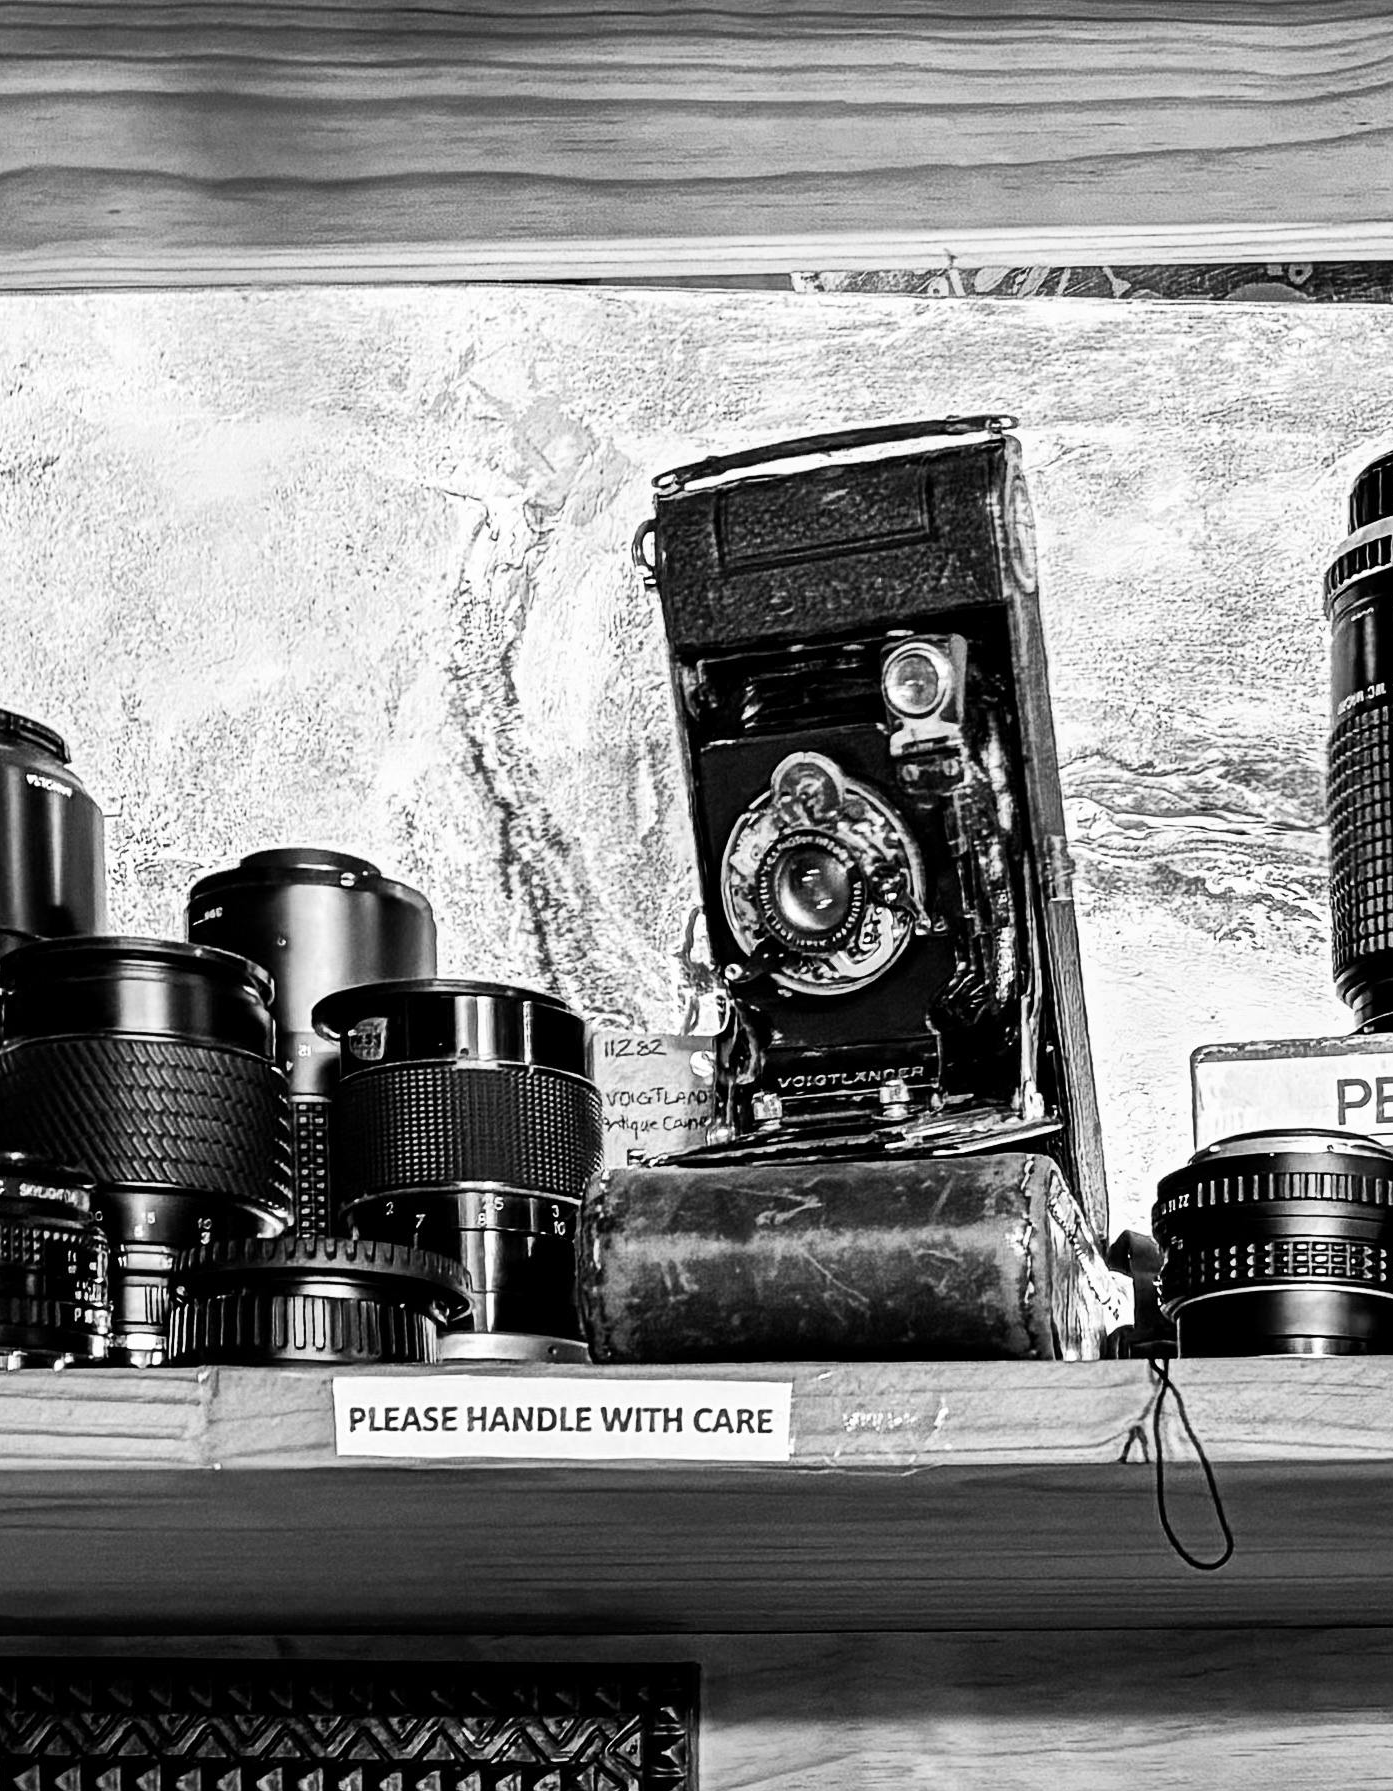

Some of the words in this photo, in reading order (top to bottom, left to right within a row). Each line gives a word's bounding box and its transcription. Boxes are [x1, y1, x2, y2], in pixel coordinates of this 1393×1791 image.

[349, 1406, 458, 1434] PLEASE
[467, 1406, 592, 1434] HANDLE
[599, 1406, 683, 1434] WITH
[692, 1406, 773, 1434] CARE
